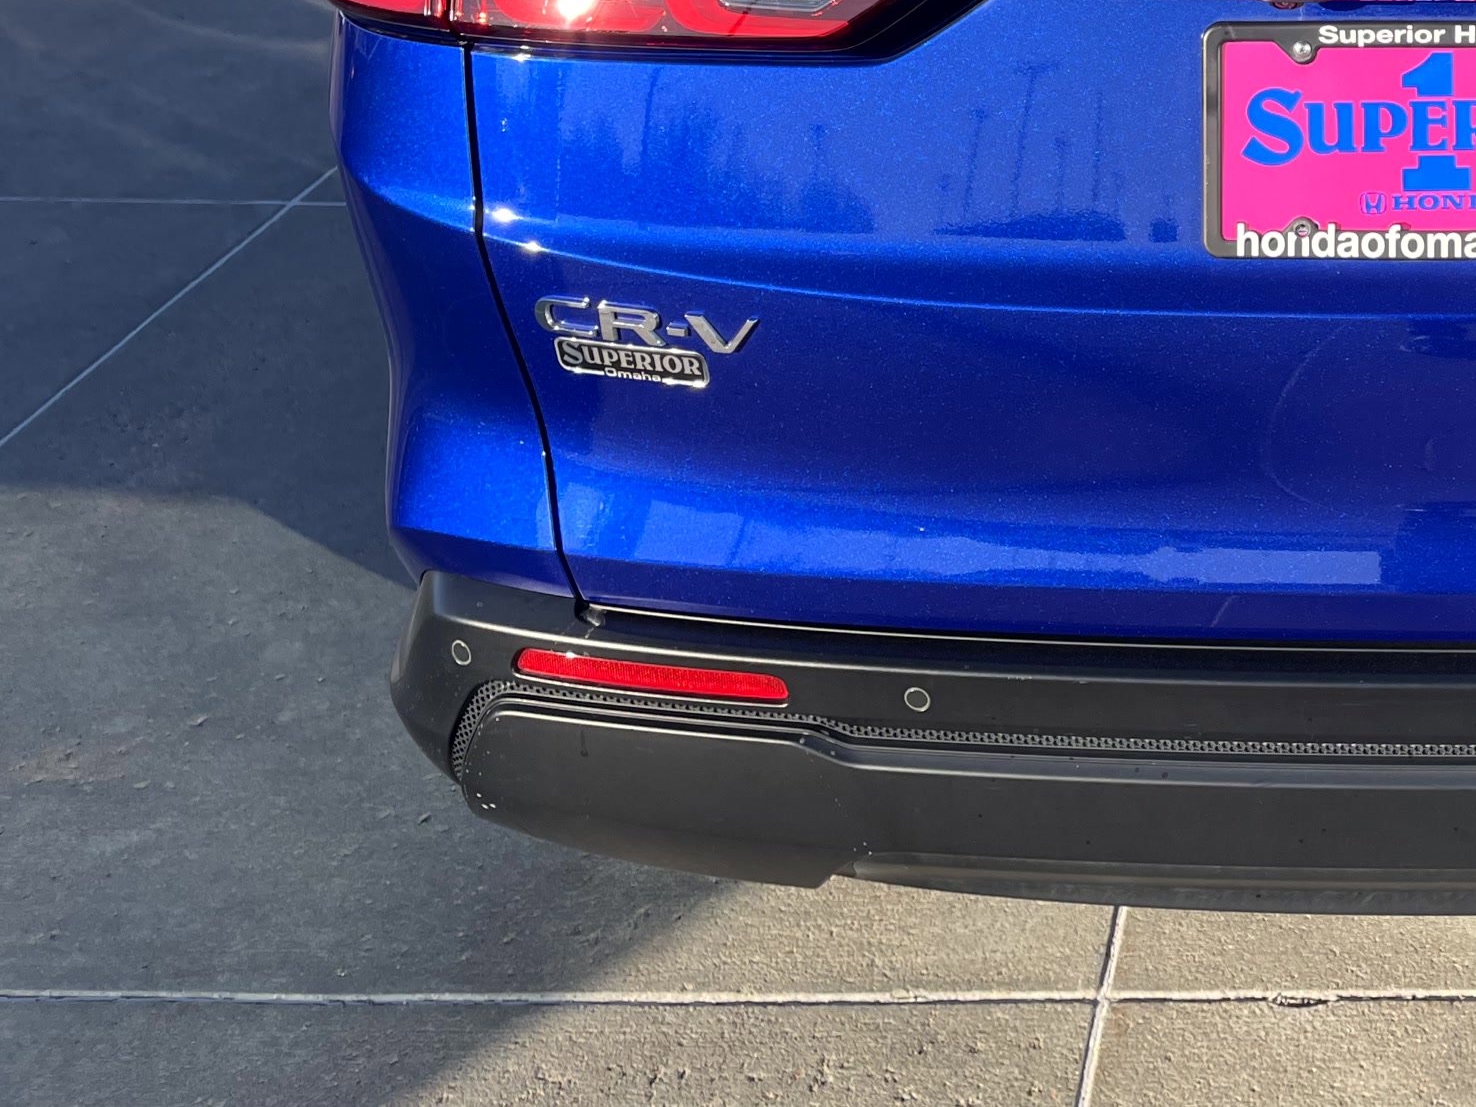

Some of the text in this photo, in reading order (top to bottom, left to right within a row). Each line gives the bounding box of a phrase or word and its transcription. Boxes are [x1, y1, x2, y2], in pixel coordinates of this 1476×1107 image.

[1318, 26, 1447, 46] Superior
[535, 294, 760, 354] CR-V
[604, 366, 661, 383] Omaha
